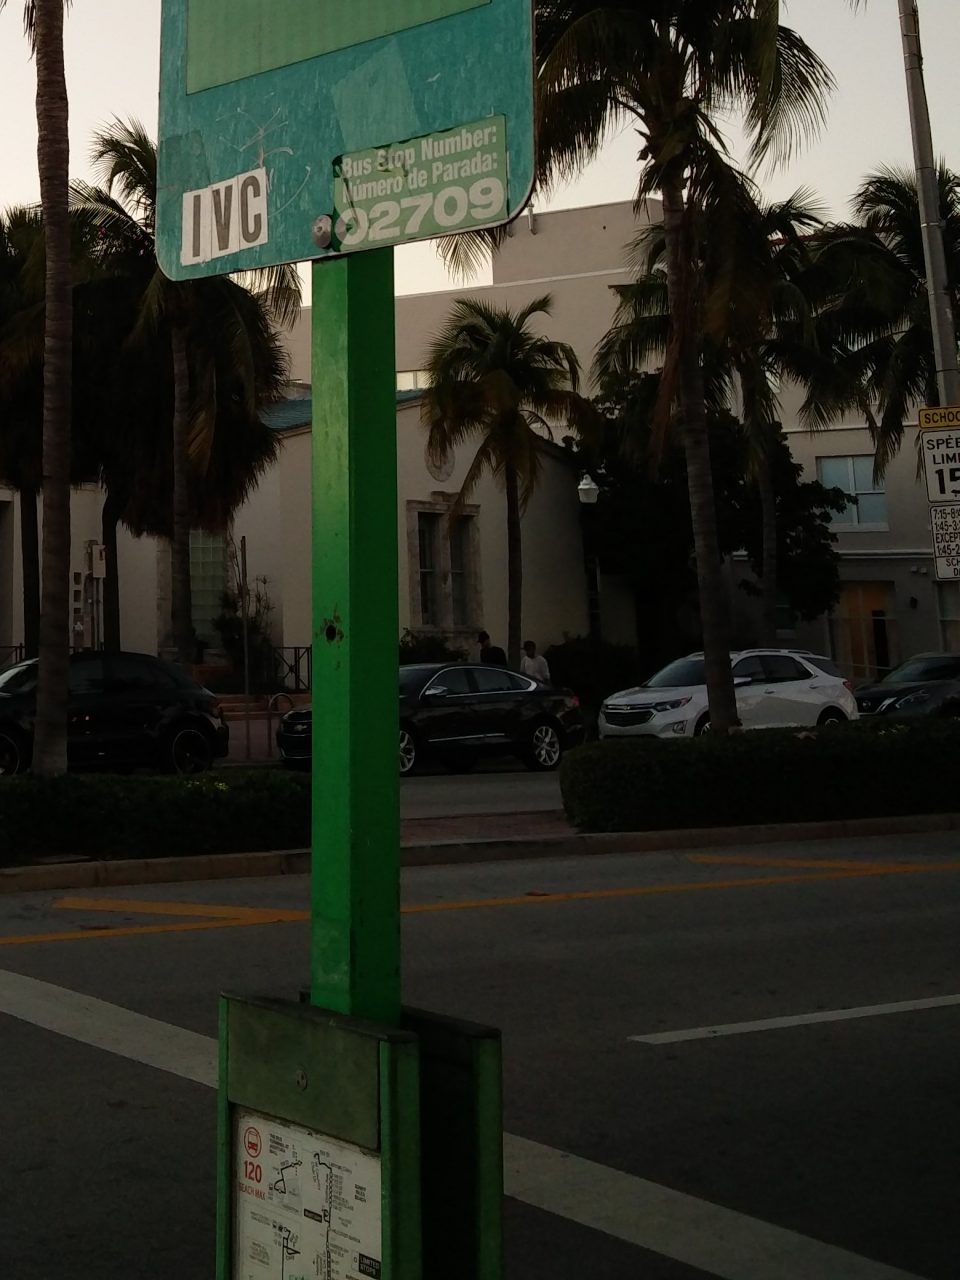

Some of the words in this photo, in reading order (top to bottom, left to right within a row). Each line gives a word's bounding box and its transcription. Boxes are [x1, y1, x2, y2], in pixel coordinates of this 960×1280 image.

[341, 155, 372, 179] Bus
[377, 146, 416, 172] Stop
[420, 126, 497, 161] Number:
[342, 171, 404, 203] Número
[407, 167, 428, 190] de
[431, 151, 498, 183] Parada:
[192, 175, 262, 258] IVC
[336, 177, 505, 246] 02709
[935, 467, 960, 494] 15
[244, 1160, 262, 1183] 120
[360, 1255, 380, 1269] LIMITED
